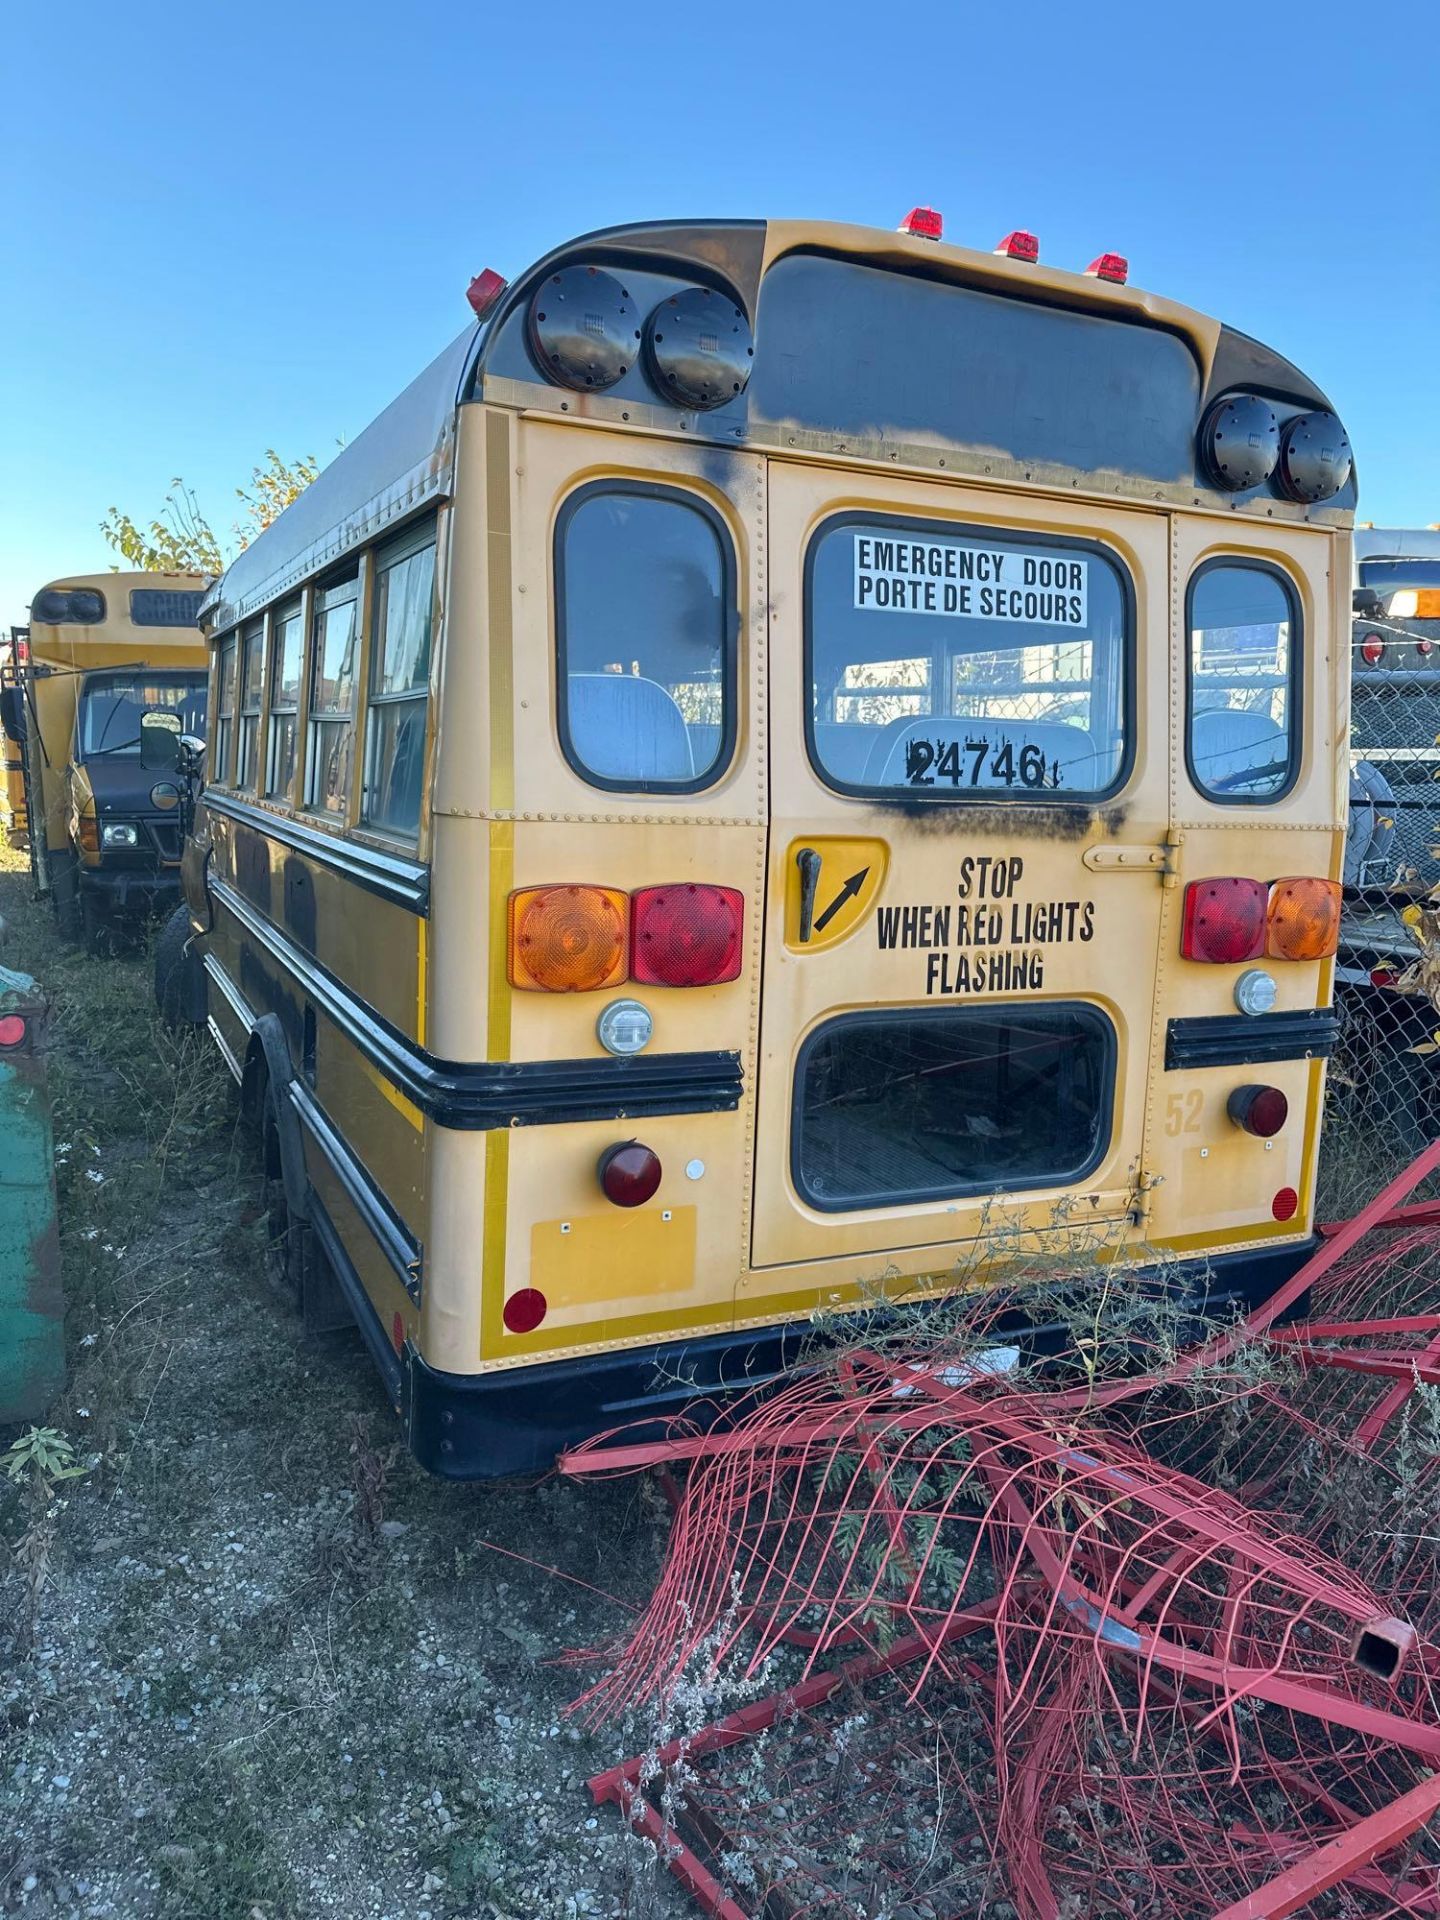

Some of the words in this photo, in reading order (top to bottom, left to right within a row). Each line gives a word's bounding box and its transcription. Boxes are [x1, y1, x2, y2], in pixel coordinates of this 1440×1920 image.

[858, 539, 1004, 583] EMERGENCY
[1023, 557, 1082, 591] DOOR
[858, 575, 937, 611] PORTE
[943, 583, 972, 614] DE
[979, 587, 1082, 624] SECOURS
[906, 740, 1045, 787] 24746
[958, 856, 1024, 899] STOP
[877, 906, 952, 949] WHEN
[956, 903, 1003, 946] RED
[1011, 901, 1095, 944] LIGHTS
[926, 948, 1044, 995] FLASHING
[1165, 1088, 1204, 1138] 52
